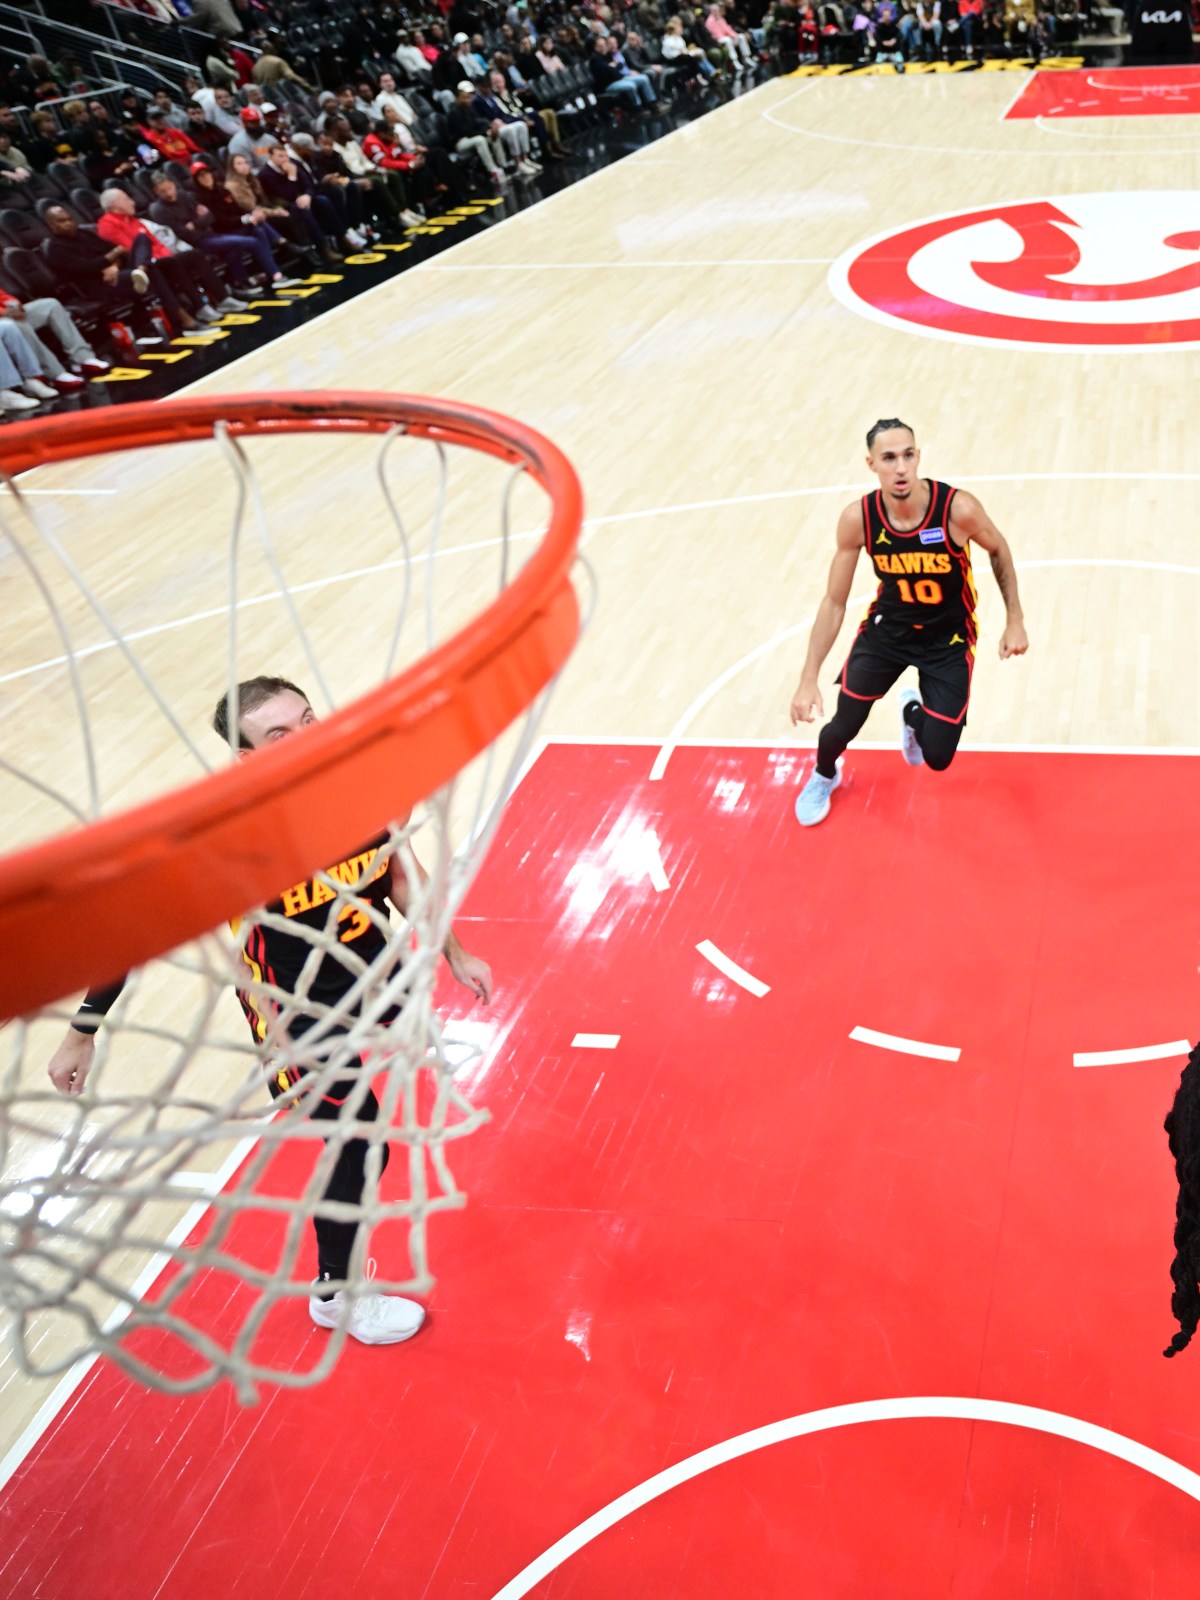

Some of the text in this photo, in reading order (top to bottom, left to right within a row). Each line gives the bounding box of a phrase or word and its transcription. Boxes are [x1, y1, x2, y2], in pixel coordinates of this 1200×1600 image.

[873, 552, 952, 574] HAWKS
[896, 579, 943, 605] 10
[337, 898, 373, 943] 3
